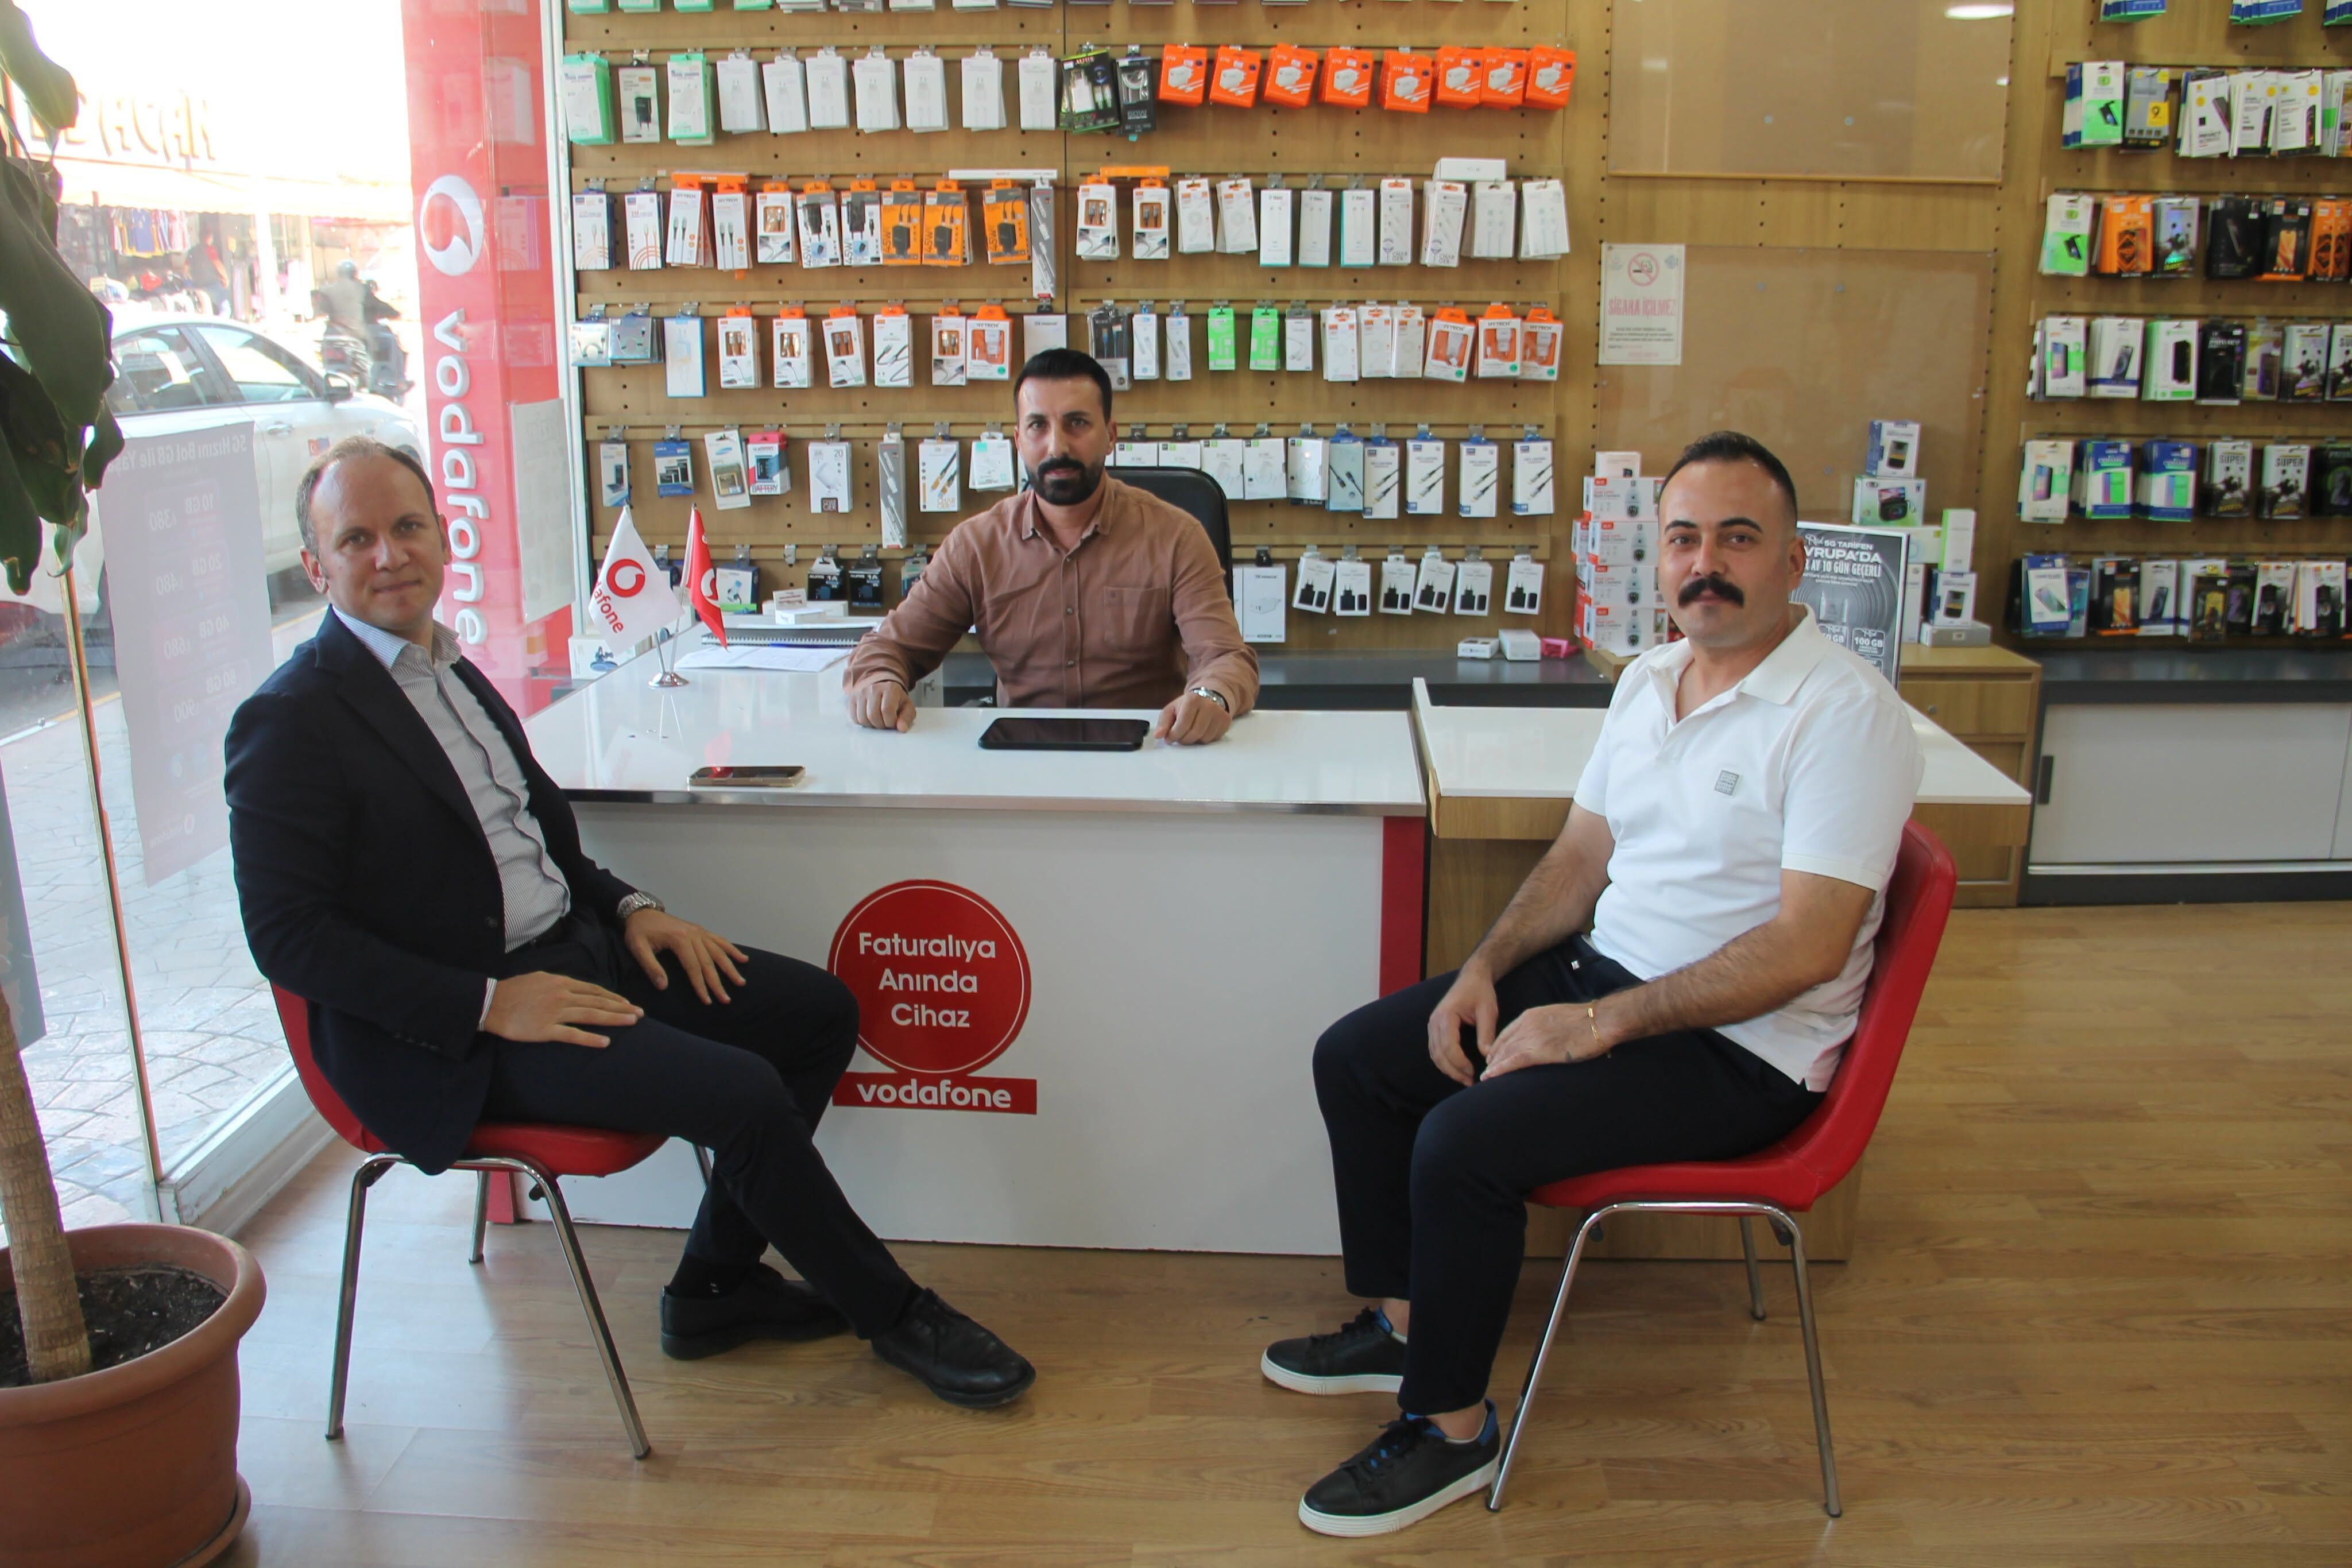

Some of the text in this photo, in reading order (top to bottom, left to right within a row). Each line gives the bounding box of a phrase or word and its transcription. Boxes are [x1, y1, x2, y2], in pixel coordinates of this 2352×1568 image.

[434, 308, 489, 645] vodafone
[752, 485, 778, 493] BATTERY
[1804, 546, 1882, 564] VRUPA'DA
[594, 581, 624, 634] afone
[1854, 637, 1883, 648] 100 GB
[859, 932, 996, 963] Faturalıya
[878, 968, 978, 993] Anında
[891, 1003, 970, 1028] Cihaz
[856, 1078, 1011, 1108] vodafone
